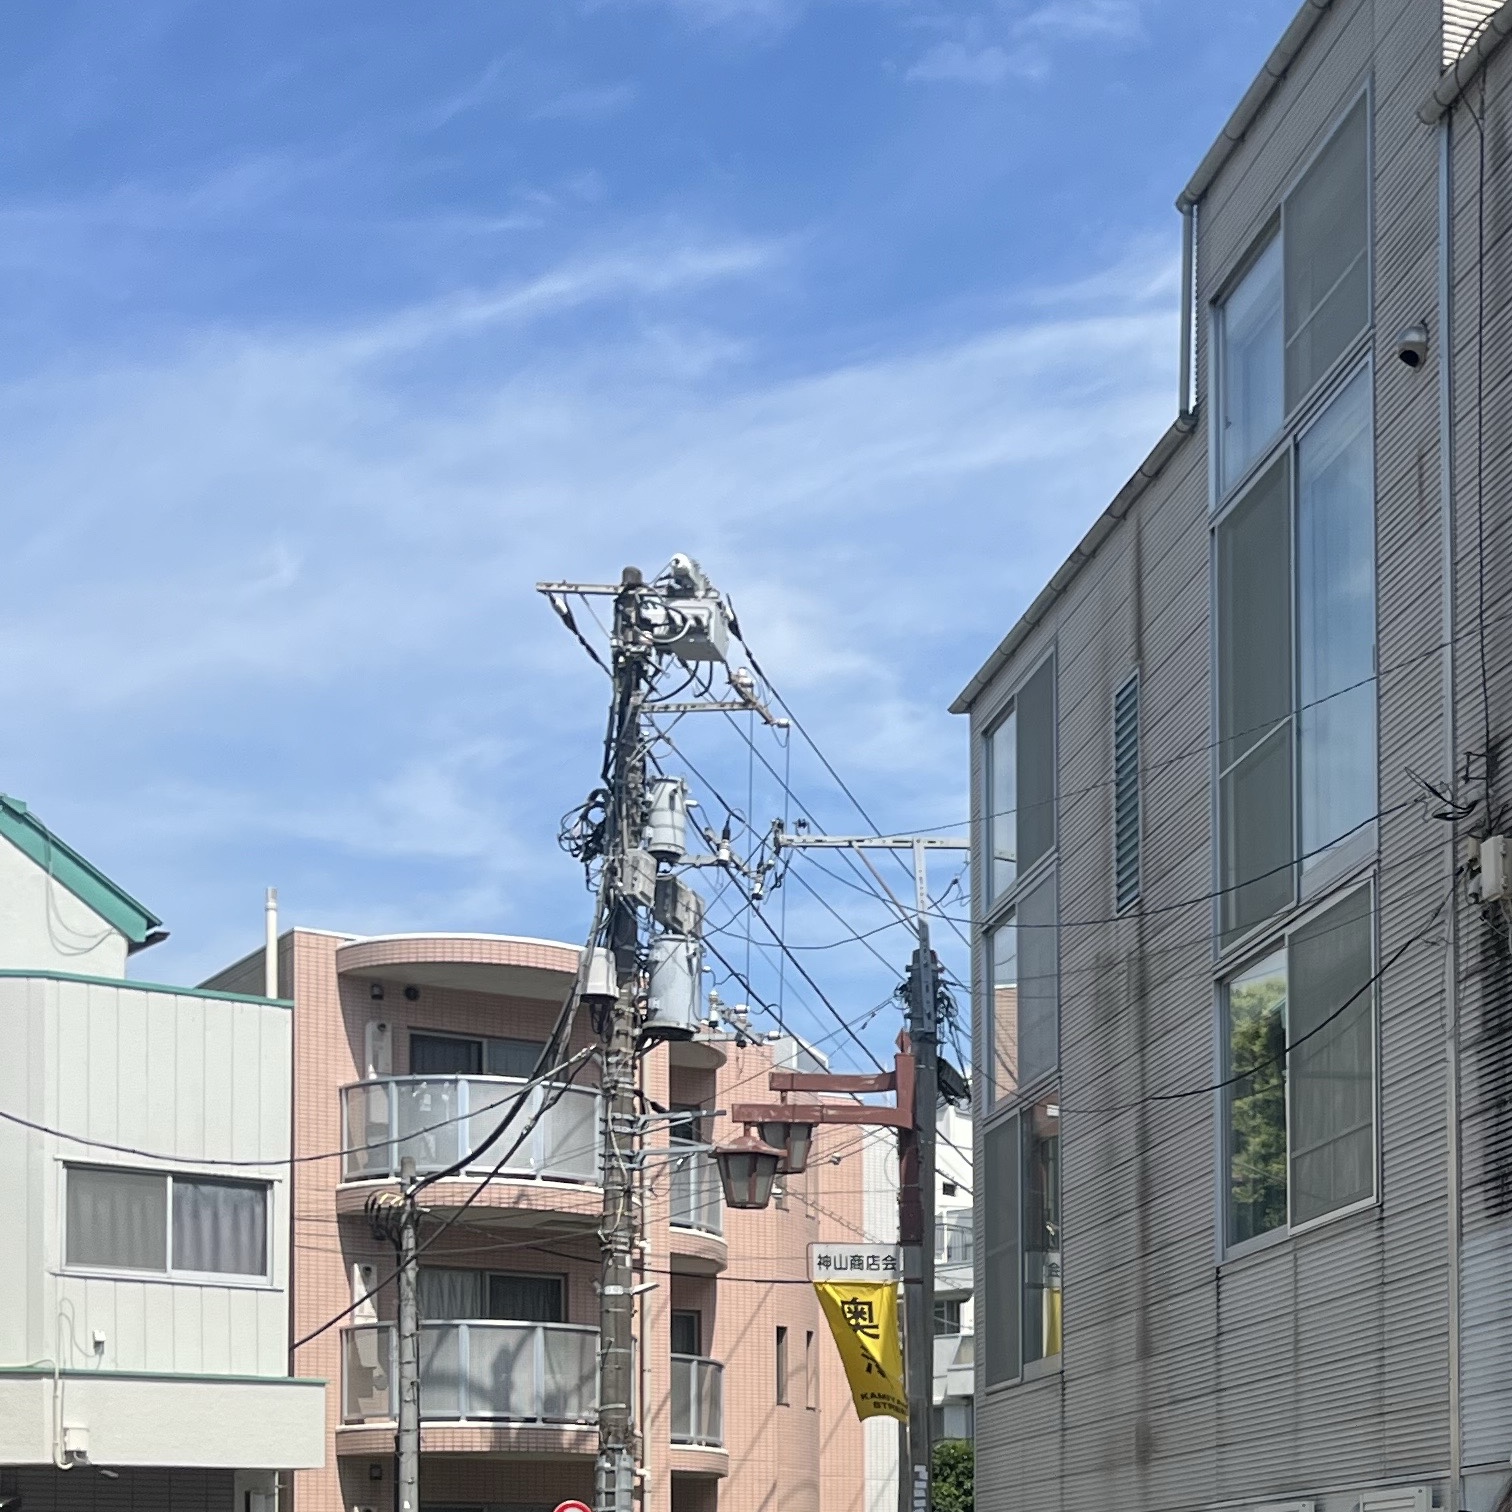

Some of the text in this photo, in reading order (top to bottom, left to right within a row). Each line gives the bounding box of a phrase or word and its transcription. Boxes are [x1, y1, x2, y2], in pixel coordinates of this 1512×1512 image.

[817, 1254, 897, 1271] 神山商店会
